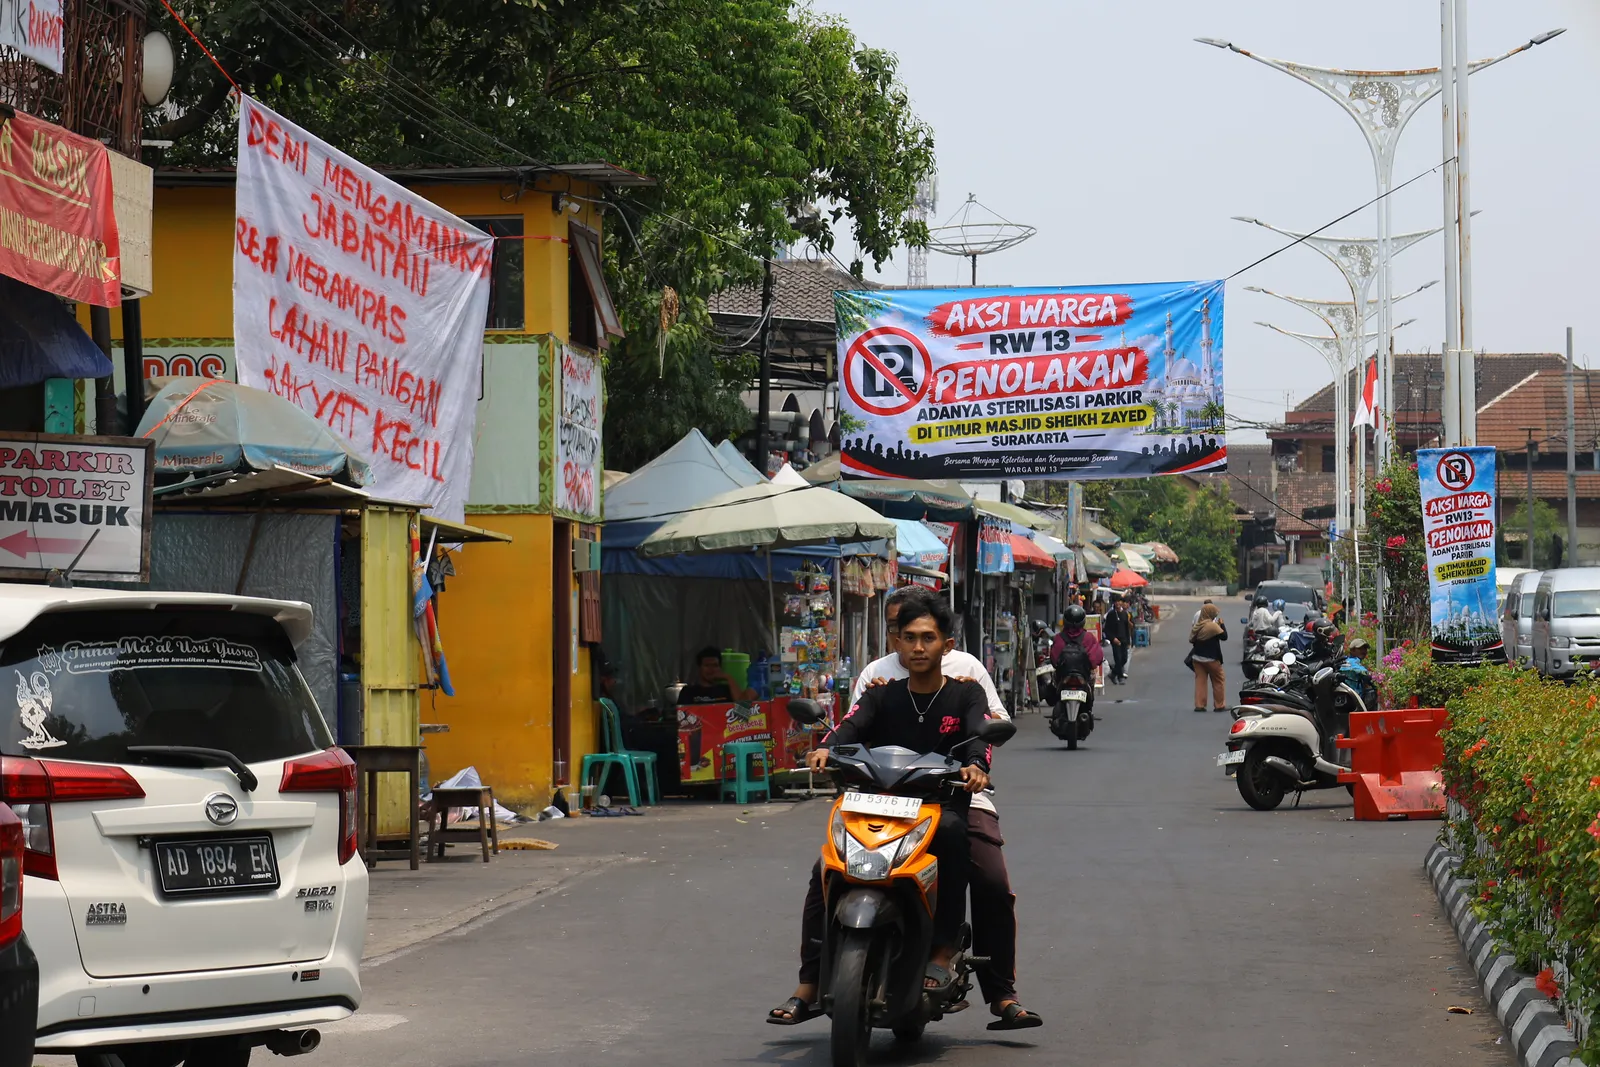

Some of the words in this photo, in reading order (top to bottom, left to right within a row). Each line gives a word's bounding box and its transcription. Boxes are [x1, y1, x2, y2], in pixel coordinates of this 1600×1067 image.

[247, 107, 309, 176] DEMI
[31, 130, 91, 198] MASUK
[303, 192, 429, 297] JABATAN
[286, 245, 407, 344] MERAMPAS
[944, 301, 1011, 332] AKSI
[1020, 295, 1118, 326] WARGA
[989, 332, 1036, 355] RW
[1042, 329, 1071, 351] 13
[268, 298, 348, 374] LAHAN
[355, 343, 442, 428] PANGAN
[934, 351, 1136, 402] PENOLAKAN
[185, 405, 200, 414] Le
[263, 354, 369, 439] RAKYAT
[372, 409, 445, 482] KECIL
[916, 404, 985, 422] ADANYA
[986, 395, 1080, 416] STERILISASI
[1084, 390, 1143, 408] PARKIR
[917, 427, 932, 440] DI
[936, 422, 981, 438] TIMUR
[986, 417, 1041, 434] MASJID
[1045, 413, 1098, 429] SHEIKH
[1101, 409, 1147, 426] ZAYED
[991, 432, 1069, 447] SURAKARTA
[0, 447, 135, 475] PARKIR
[162, 452, 224, 467] Minerale
[943, 457, 971, 466] Bersama
[972, 457, 999, 466] Menjaga
[1034, 455, 1047, 463] dan
[1091, 454, 1118, 463] Bersama
[1004, 466, 1032, 474] WARGA
[0, 475, 131, 501] TOILET
[1, 500, 130, 527] MASUK
[1430, 498, 1455, 514] AKSI
[1432, 545, 1459, 557] ADANYA
[68, 645, 116, 660] Inna
[846, 793, 861, 802] AD
[867, 794, 899, 806] 5376
[166, 848, 189, 876] AD
[197, 846, 237, 875] 1894
[249, 844, 272, 872] EK
[296, 885, 336, 899] SIGRA
[88, 902, 127, 914] ASTRA
